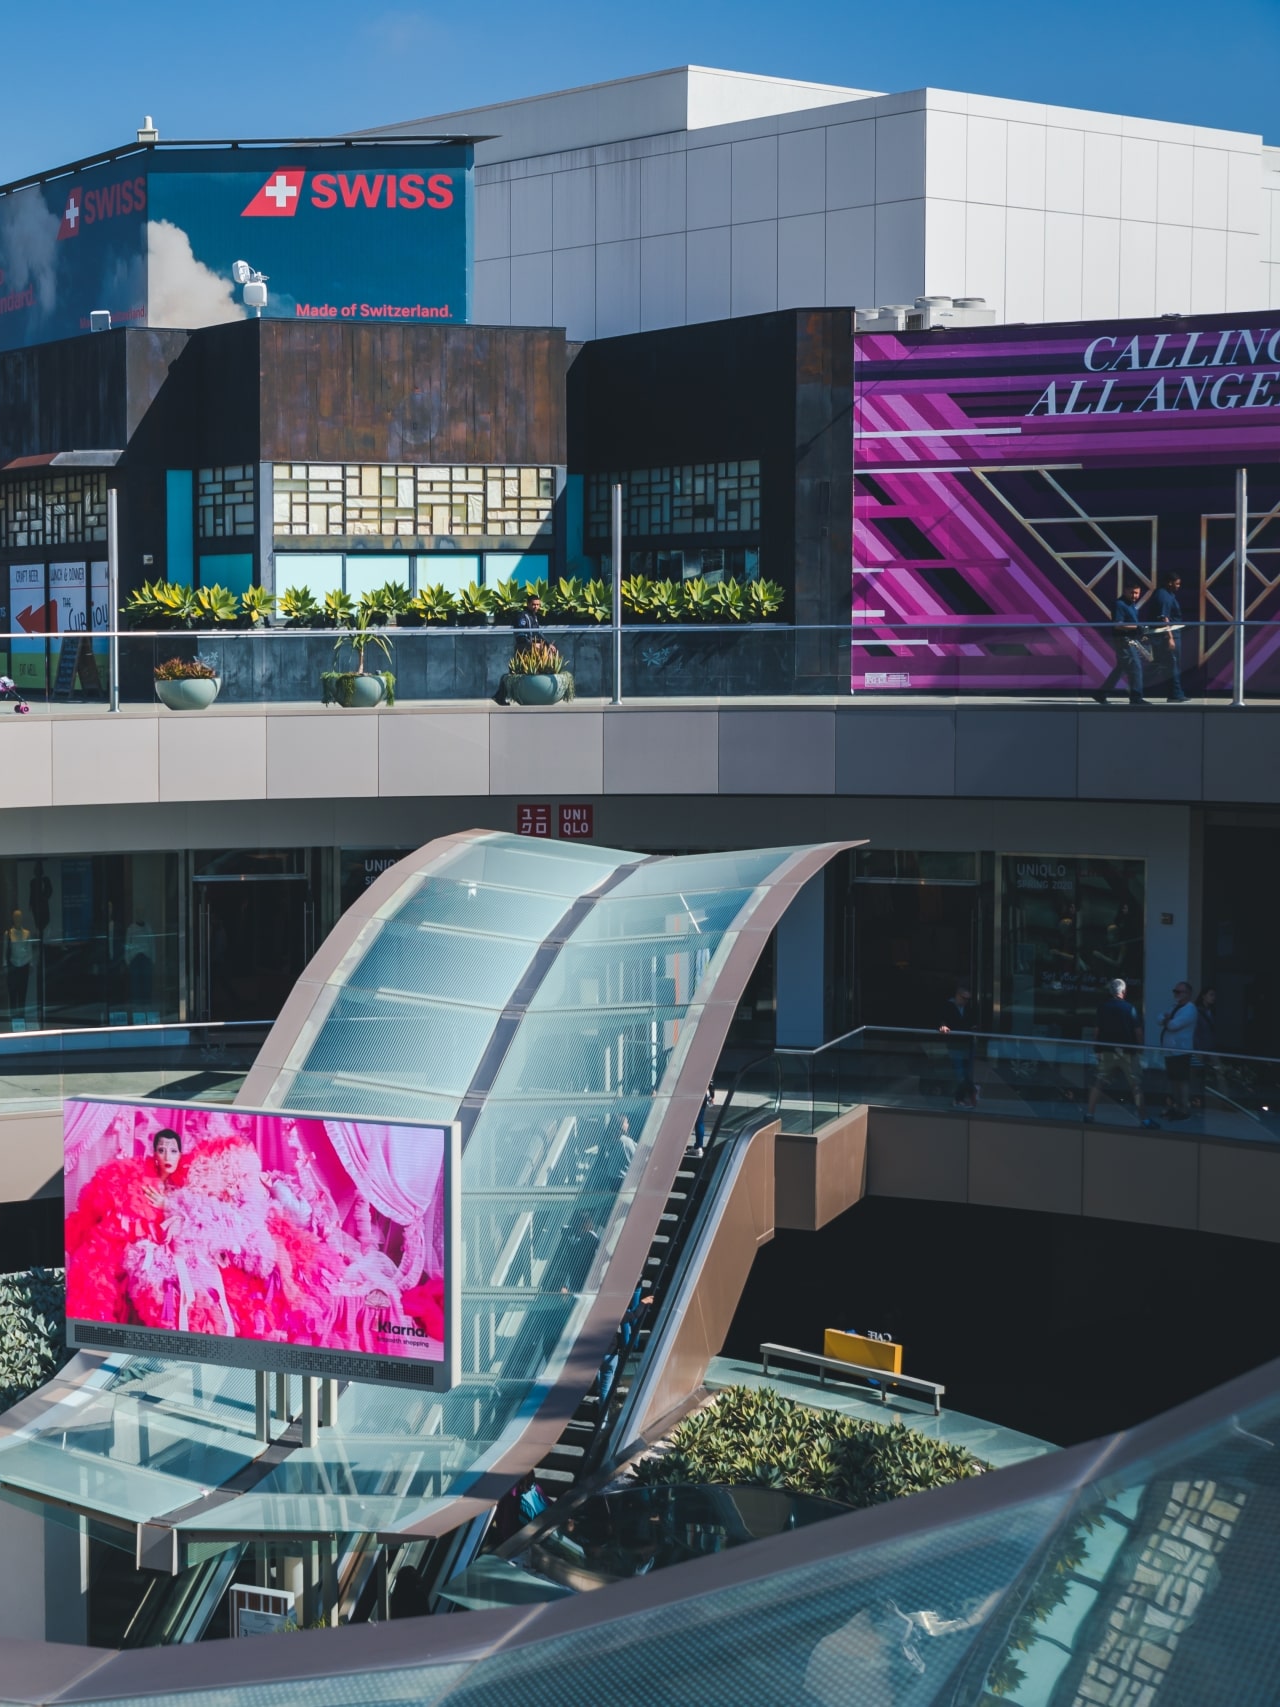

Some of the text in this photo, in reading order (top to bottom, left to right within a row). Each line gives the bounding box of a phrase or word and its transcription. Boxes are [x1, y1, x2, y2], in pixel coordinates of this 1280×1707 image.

[84, 177, 146, 224] SWISS
[311, 173, 454, 209] SWISS
[296, 303, 453, 318] Made of Switzerland.
[1084, 328, 1280, 372] CALLIN
[1025, 372, 1280, 417] ALL ANGE
[1016, 863, 1066, 878] UNIQLO
[403, 1339, 429, 1348] shopping
